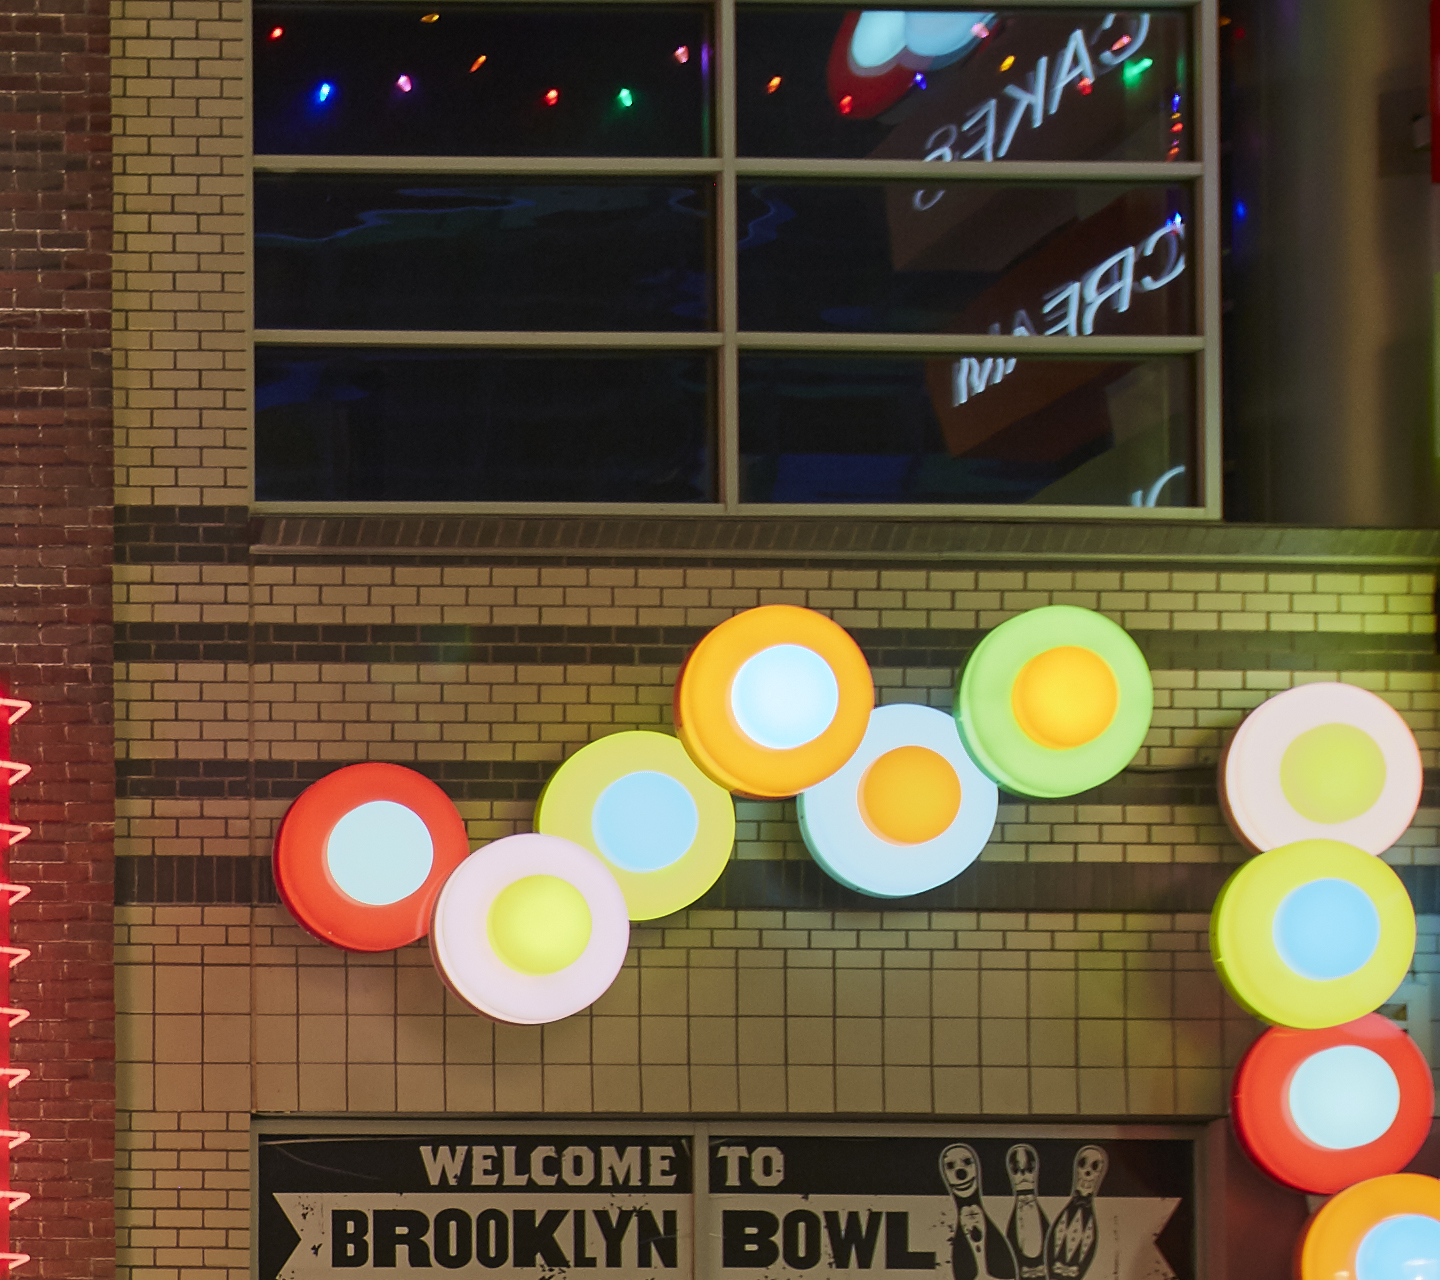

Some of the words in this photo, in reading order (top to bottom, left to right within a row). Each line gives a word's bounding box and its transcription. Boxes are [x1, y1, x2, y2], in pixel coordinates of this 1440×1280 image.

[419, 1145, 677, 1187] WELCOME
[716, 1146, 785, 1187] TO
[331, 1208, 678, 1268] BROOKLYN
[721, 1209, 936, 1270] BOWL
